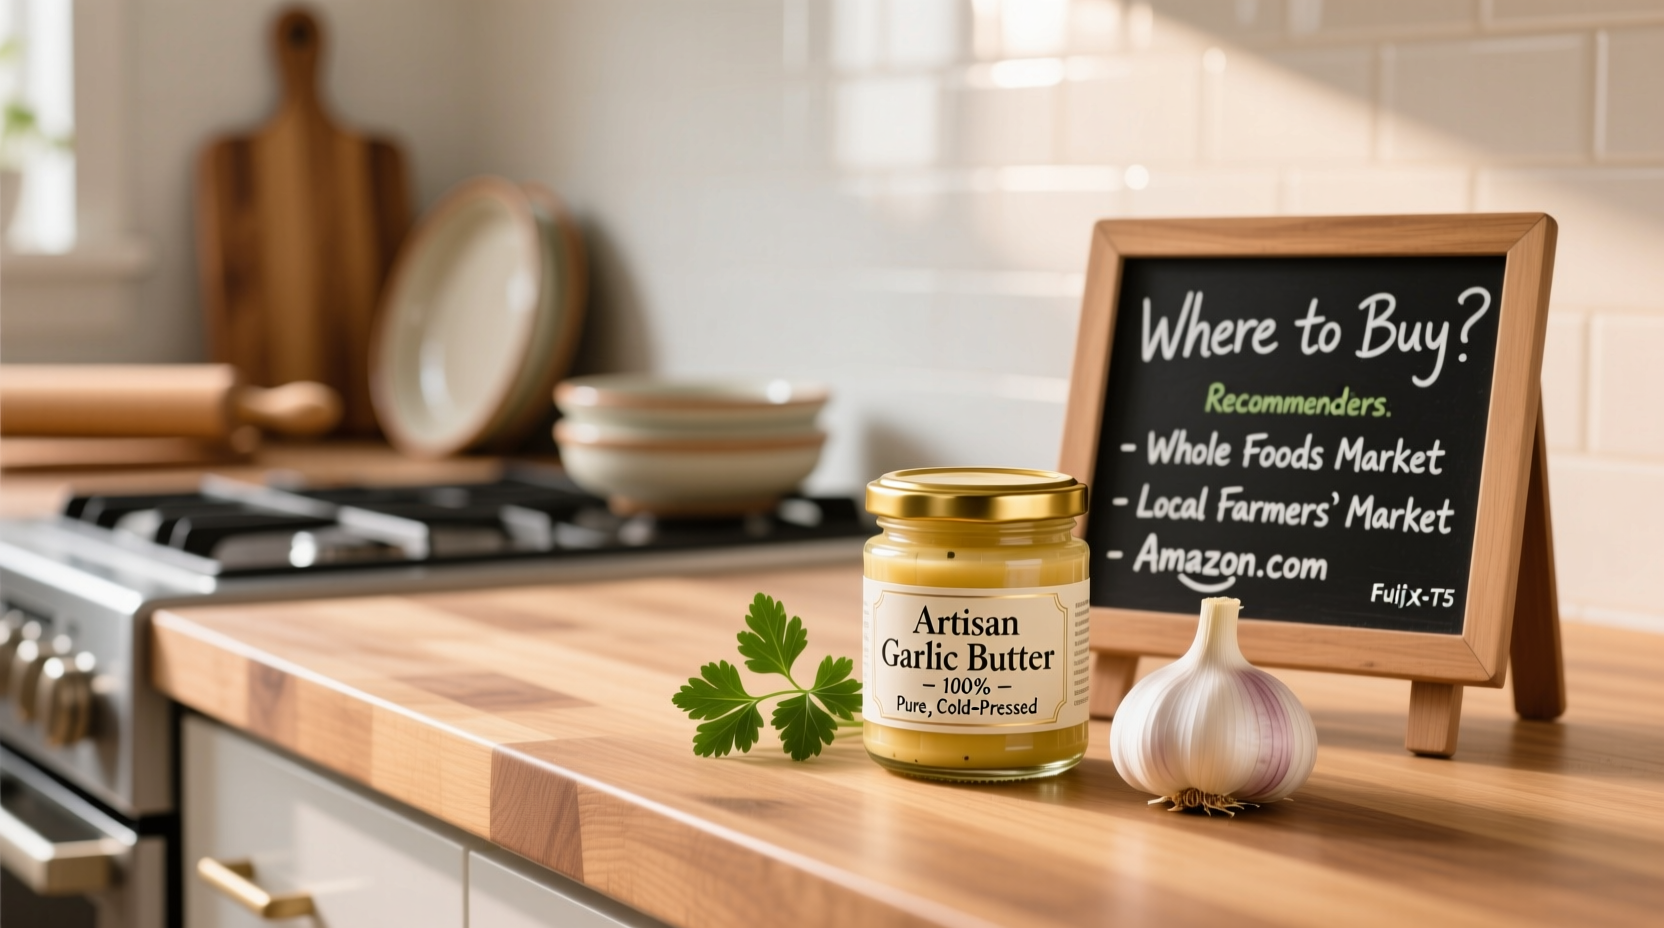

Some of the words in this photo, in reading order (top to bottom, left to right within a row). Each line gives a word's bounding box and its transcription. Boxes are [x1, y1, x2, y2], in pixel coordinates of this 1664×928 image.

[1142, 291, 1278, 362] Where
[1295, 298, 1341, 355] to
[1355, 287, 1491, 388] Buy?
[1205, 382, 1391, 417] Recommenders.
[1148, 429, 1231, 466] Whole
[1242, 433, 1324, 470] Foods
[1334, 437, 1445, 475] Market
[1136, 483, 1208, 521] Local
[1217, 486, 1339, 528] Farmers'
[1345, 495, 1454, 534] Market
[1133, 533, 1327, 581] Amazon.com
[913, 605, 1019, 636] Artisan
[882, 639, 957, 670] Garlic
[967, 643, 1054, 671] Butter
[943, 677, 991, 695] 100%
[897, 695, 932, 718] Pure,
[937, 697, 1038, 716] Cold-Pressed
